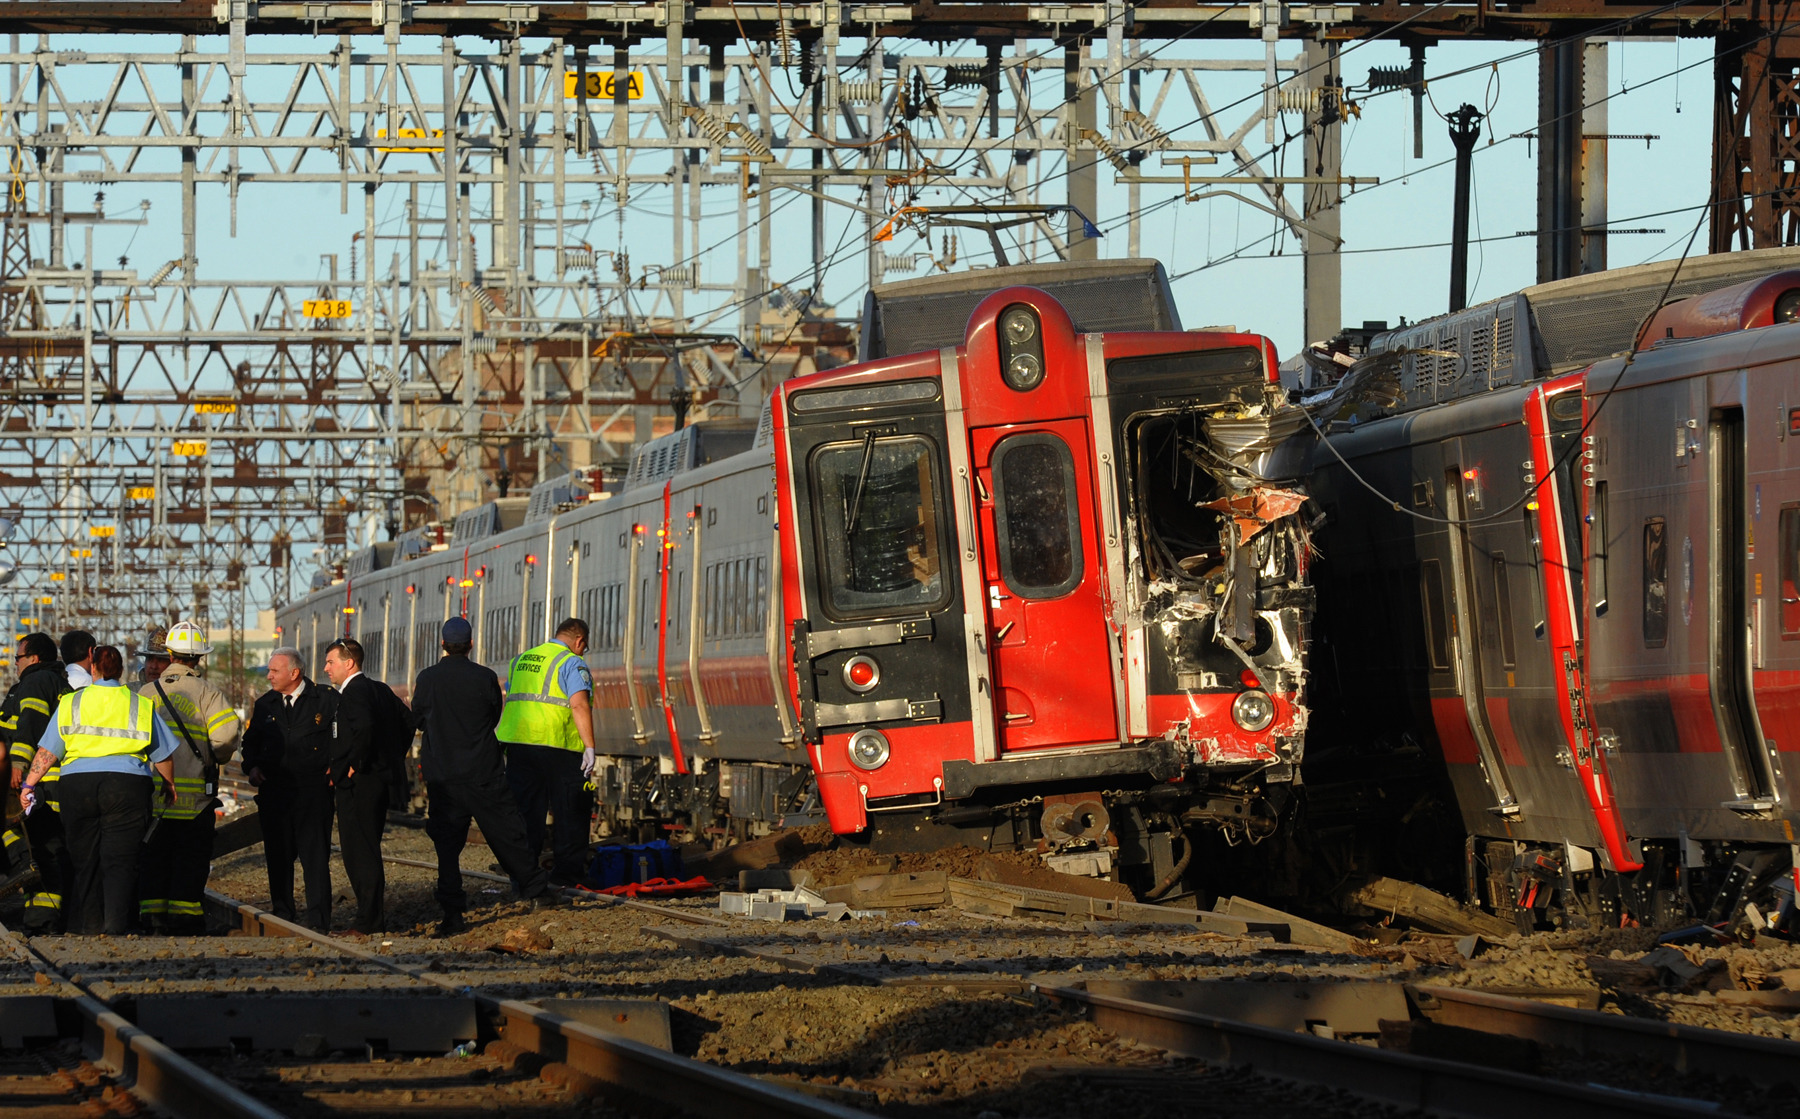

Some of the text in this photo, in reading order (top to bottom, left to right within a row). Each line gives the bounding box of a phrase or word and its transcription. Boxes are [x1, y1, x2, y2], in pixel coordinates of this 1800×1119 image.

[568, 73, 641, 97] 736A
[307, 301, 347, 317] 738
[516, 663, 541, 673] SERVICES
